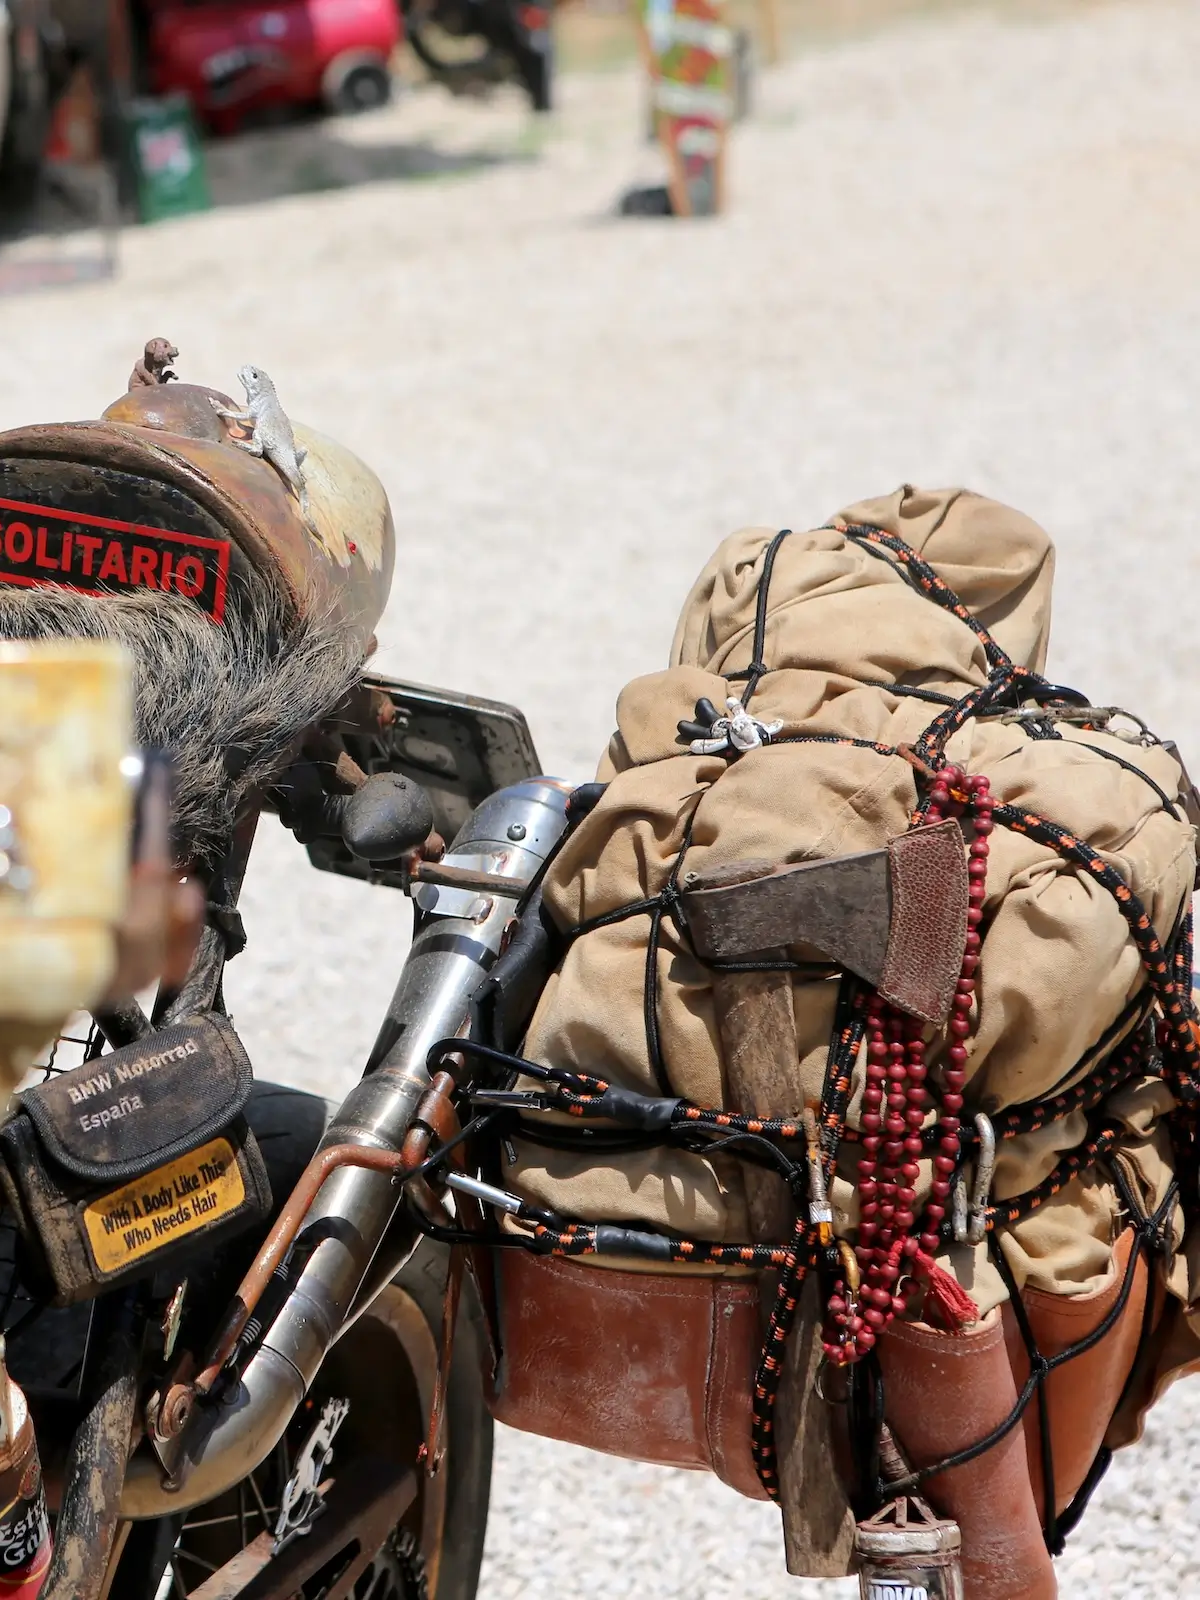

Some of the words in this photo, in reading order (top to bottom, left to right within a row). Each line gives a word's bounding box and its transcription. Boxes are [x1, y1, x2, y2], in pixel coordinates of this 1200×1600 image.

[67, 1072, 112, 1105] BMW
[114, 1038, 199, 1083] Motorrad
[79, 1095, 144, 1132] España
[101, 1203, 132, 1236] With
[132, 1199, 143, 1221] A
[141, 1184, 174, 1215] Body
[172, 1172, 200, 1199] Like
[198, 1157, 227, 1185] This
[123, 1226, 152, 1251] Who
[151, 1203, 192, 1238] Needs
[190, 1189, 218, 1217] Hair
